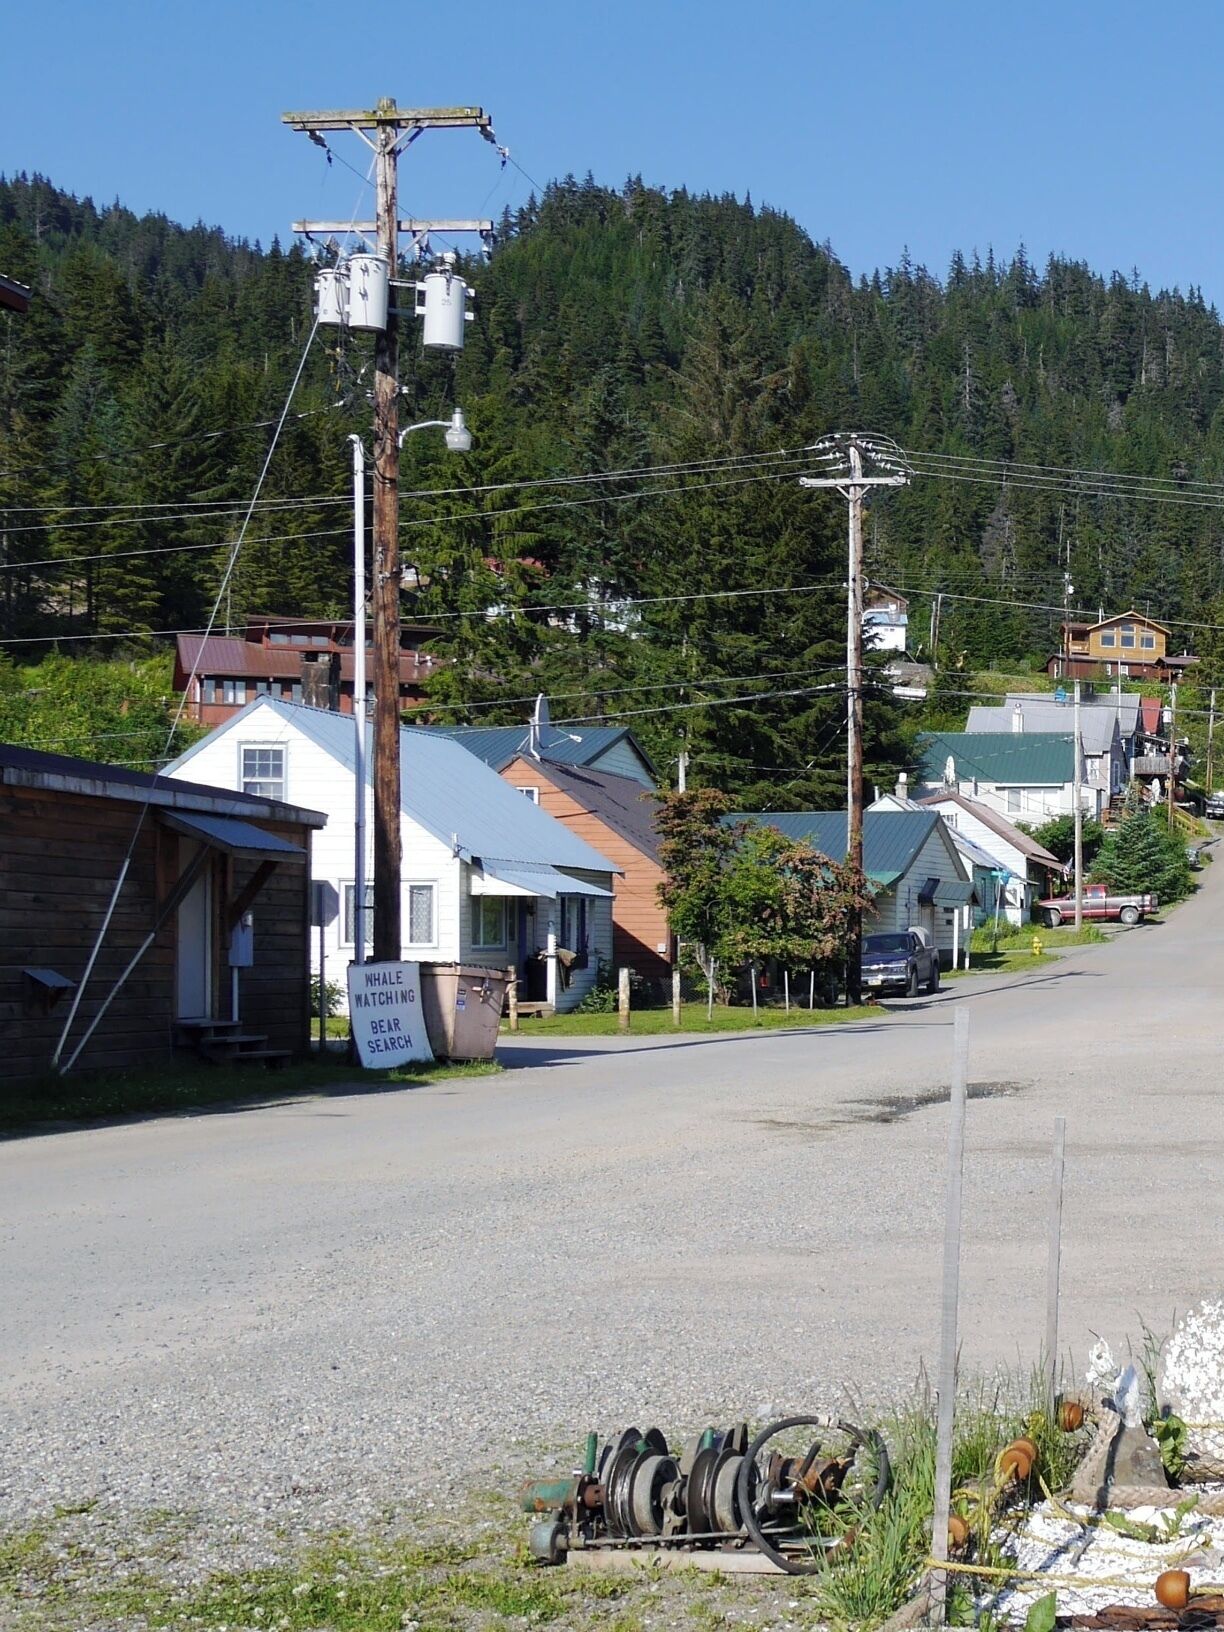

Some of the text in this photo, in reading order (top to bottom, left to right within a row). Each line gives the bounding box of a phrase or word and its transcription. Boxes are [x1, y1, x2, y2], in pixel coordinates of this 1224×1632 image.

[365, 971, 403, 987] WHALE
[354, 989, 415, 1008] WATCHING
[370, 1018, 402, 1035] BEAR
[367, 1034, 413, 1054] SEARCH
